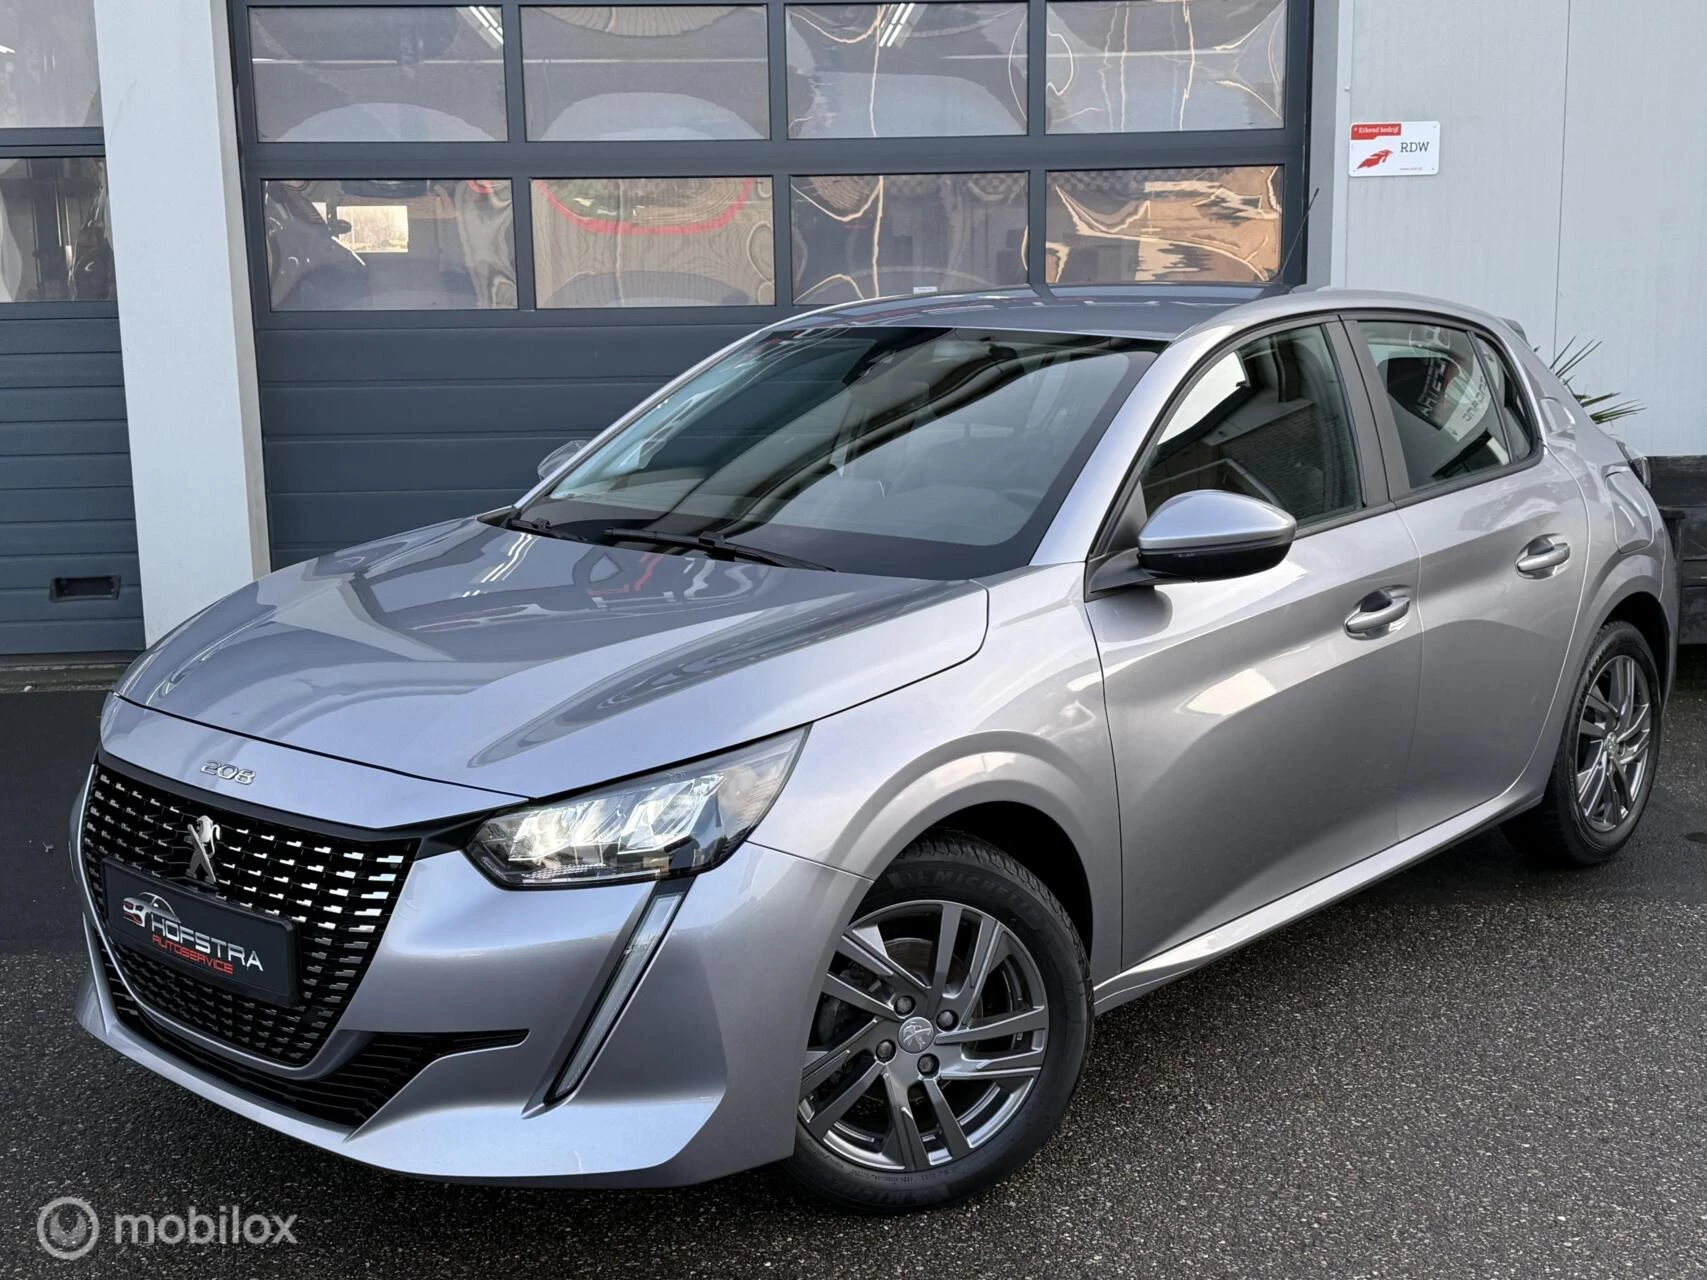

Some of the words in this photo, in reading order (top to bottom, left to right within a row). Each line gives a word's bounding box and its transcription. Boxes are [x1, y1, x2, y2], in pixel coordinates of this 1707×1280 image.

[1400, 142, 1429, 153] RDW
[200, 760, 256, 785] 208
[151, 911, 264, 972] HOFSTRA
[152, 935, 234, 975] AUTOSERVICE
